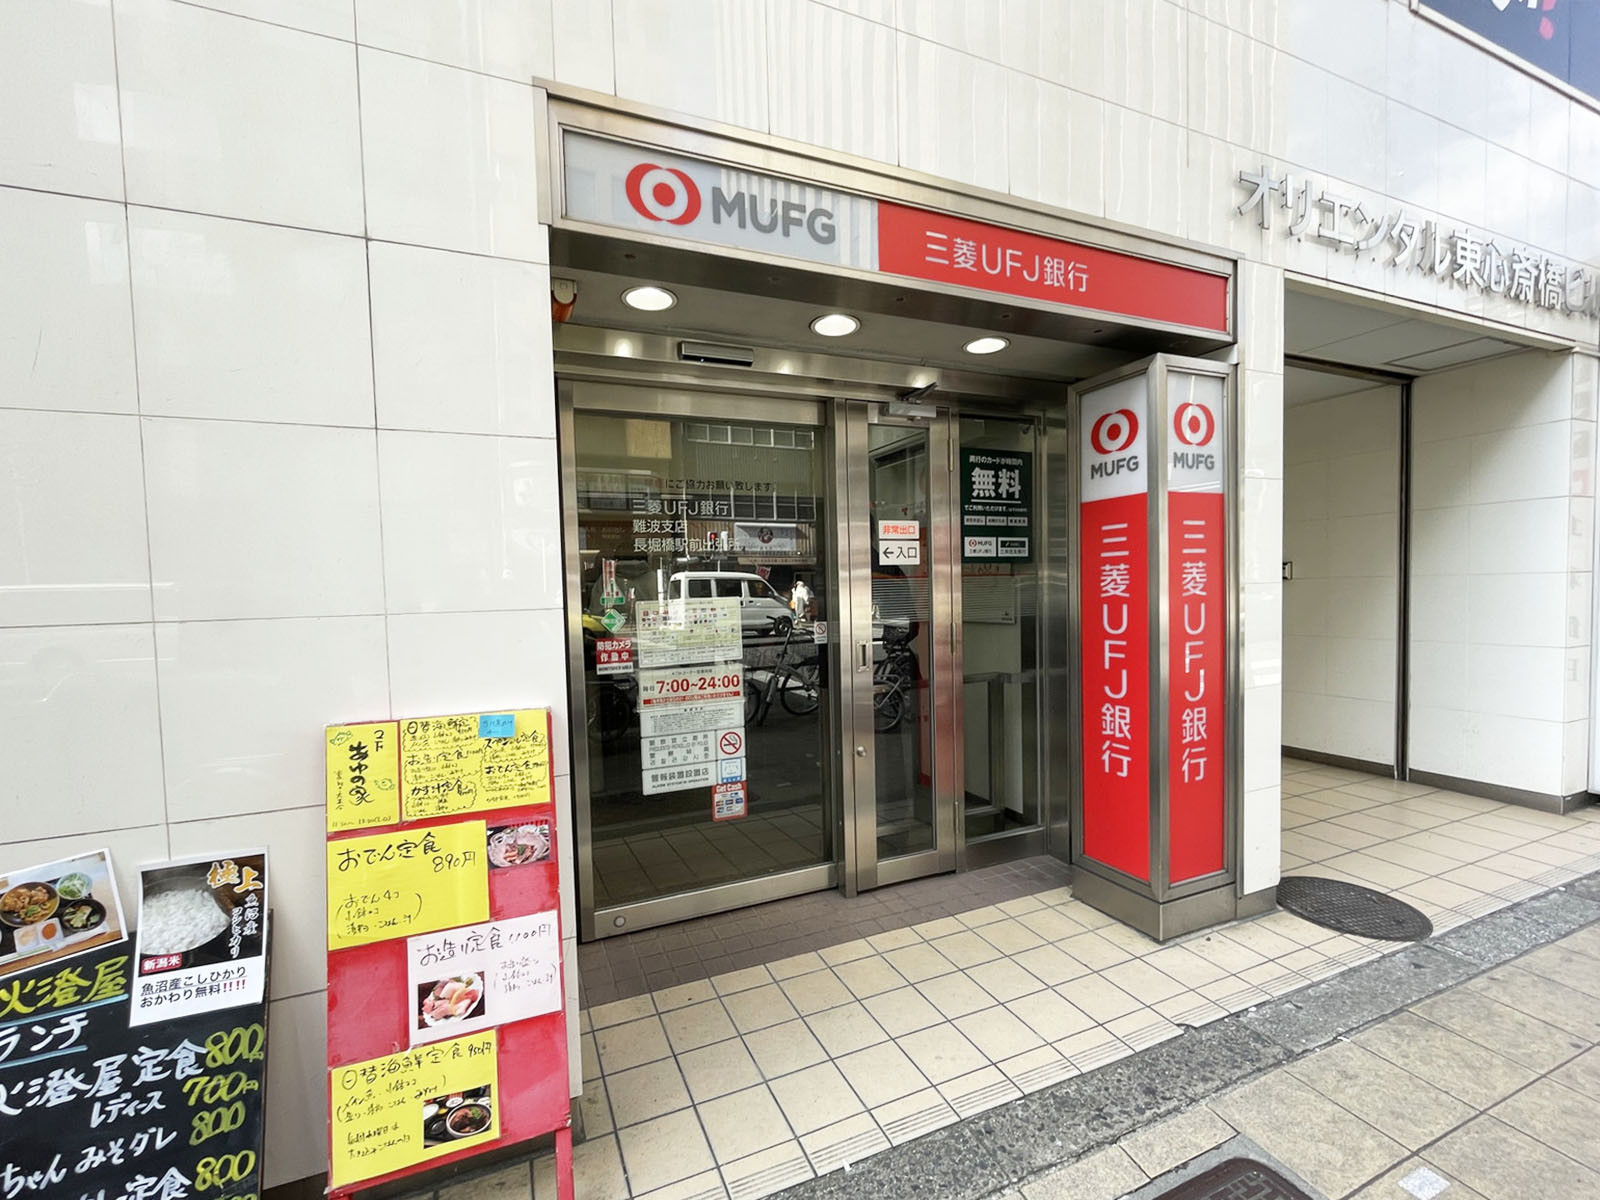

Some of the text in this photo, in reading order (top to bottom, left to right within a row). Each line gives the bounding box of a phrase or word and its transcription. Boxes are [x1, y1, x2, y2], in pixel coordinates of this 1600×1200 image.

[711, 189, 837, 246] MUFG
[924, 231, 1090, 292] 三菱UFJ銀行
[1090, 455, 1139, 480] MUFG
[1173, 452, 1215, 471] MUFG
[971, 467, 1022, 499] 無料
[632, 499, 729, 517] 三菱UFJ銀行
[632, 519, 688, 535] 難波支店
[881, 524, 917, 535] 非常出口
[896, 546, 917, 559] 入口
[596, 639, 632, 651] 防犯カメラ
[1100, 523, 1131, 778] 三菱UFJ銀行
[1182, 520, 1207, 784] 三菱UFJ銀行
[337, 832, 442, 872] おでん定食
[432, 850, 476, 872] 890円
[207, 860, 263, 893] 極上
[417, 926, 503, 967] お造り定食
[143, 955, 182, 971] 新潟米
[140, 966, 247, 995] 魚沼産こしひかり
[90, 1090, 167, 1128] レディース
[189, 1101, 246, 1146] 800
